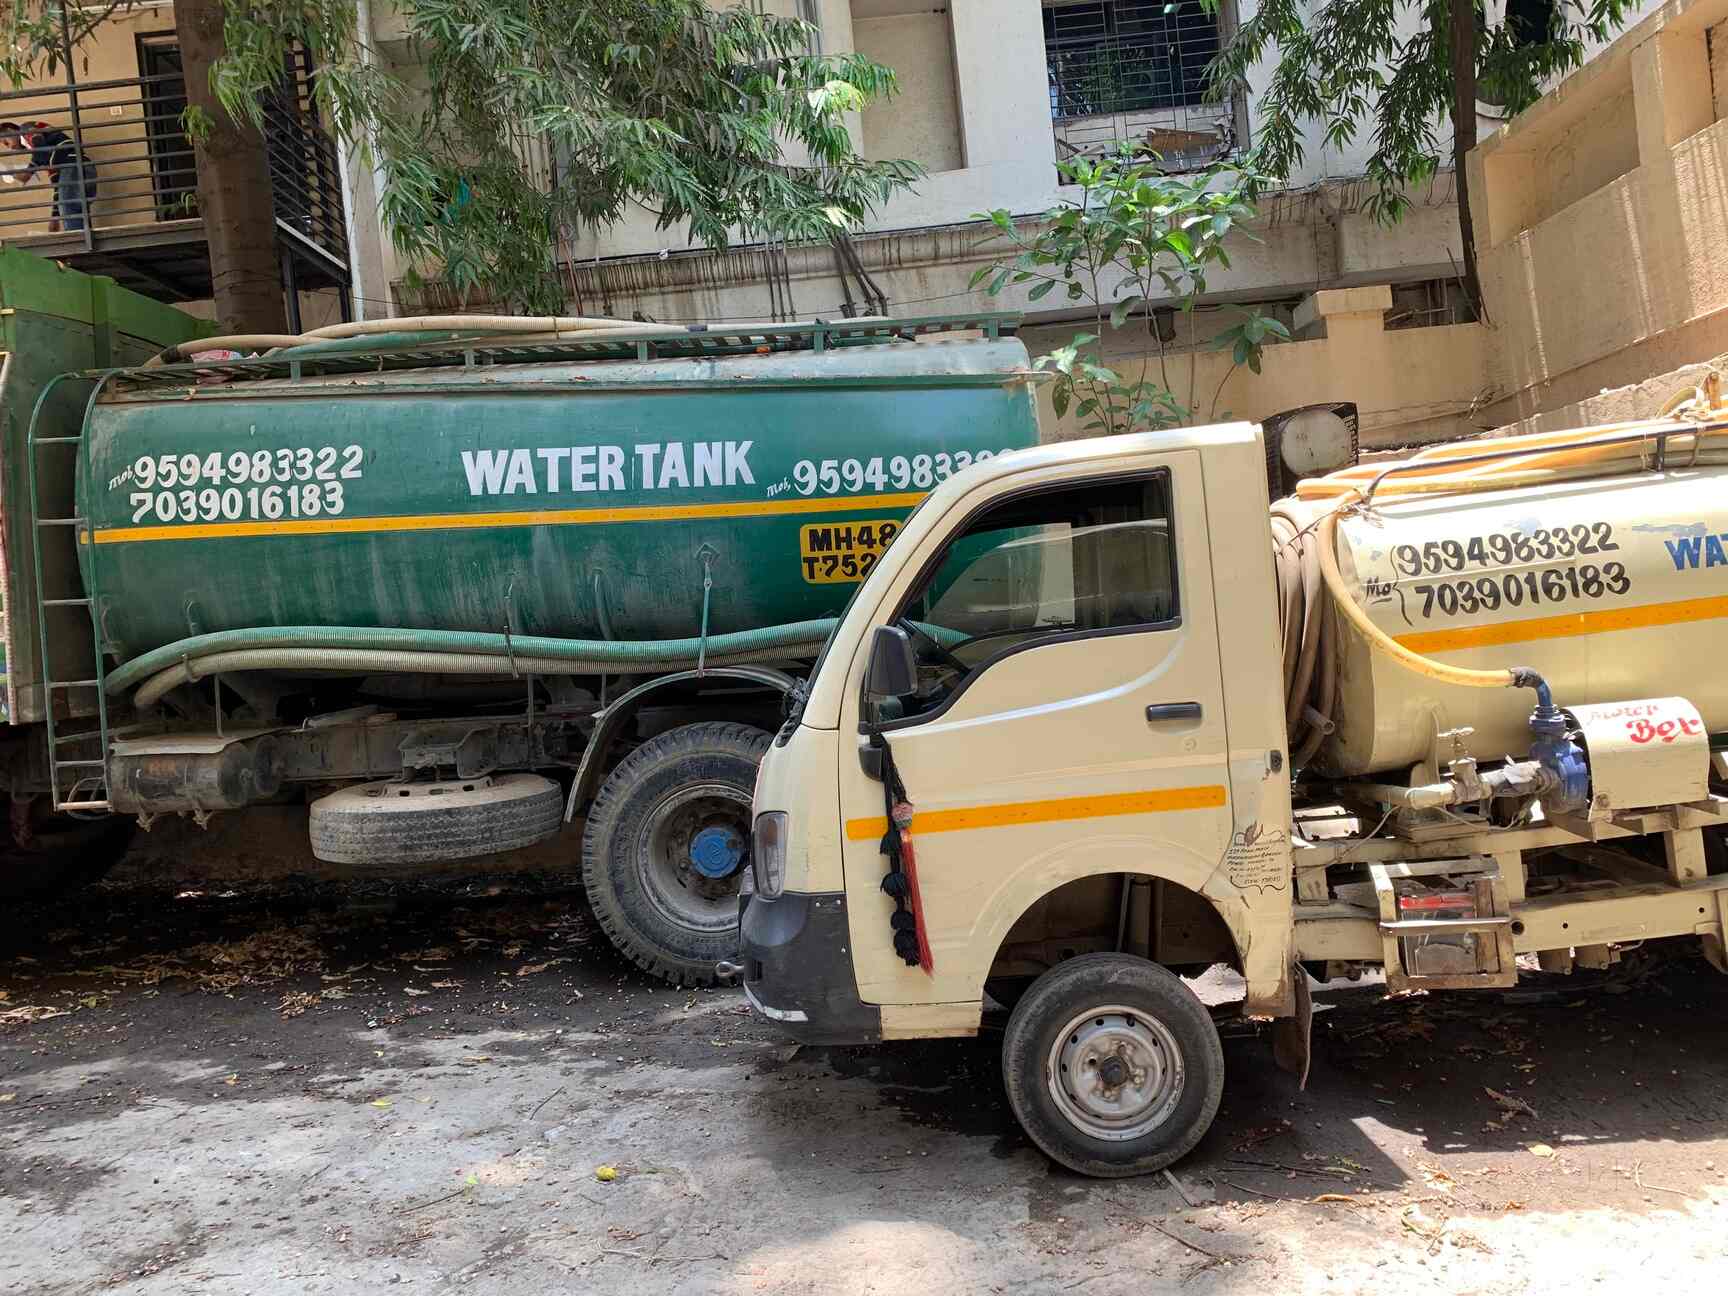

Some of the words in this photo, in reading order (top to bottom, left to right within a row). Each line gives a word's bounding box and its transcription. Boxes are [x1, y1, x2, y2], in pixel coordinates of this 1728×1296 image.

[134, 444, 364, 489] 9594983322
[461, 445, 626, 496] WATER
[635, 440, 756, 490] TANK
[793, 448, 1014, 496] 9594983
[130, 480, 345, 524] 7039016183
[1397, 521, 1620, 577] 9594983322
[1414, 561, 1631, 619] 7039016183
